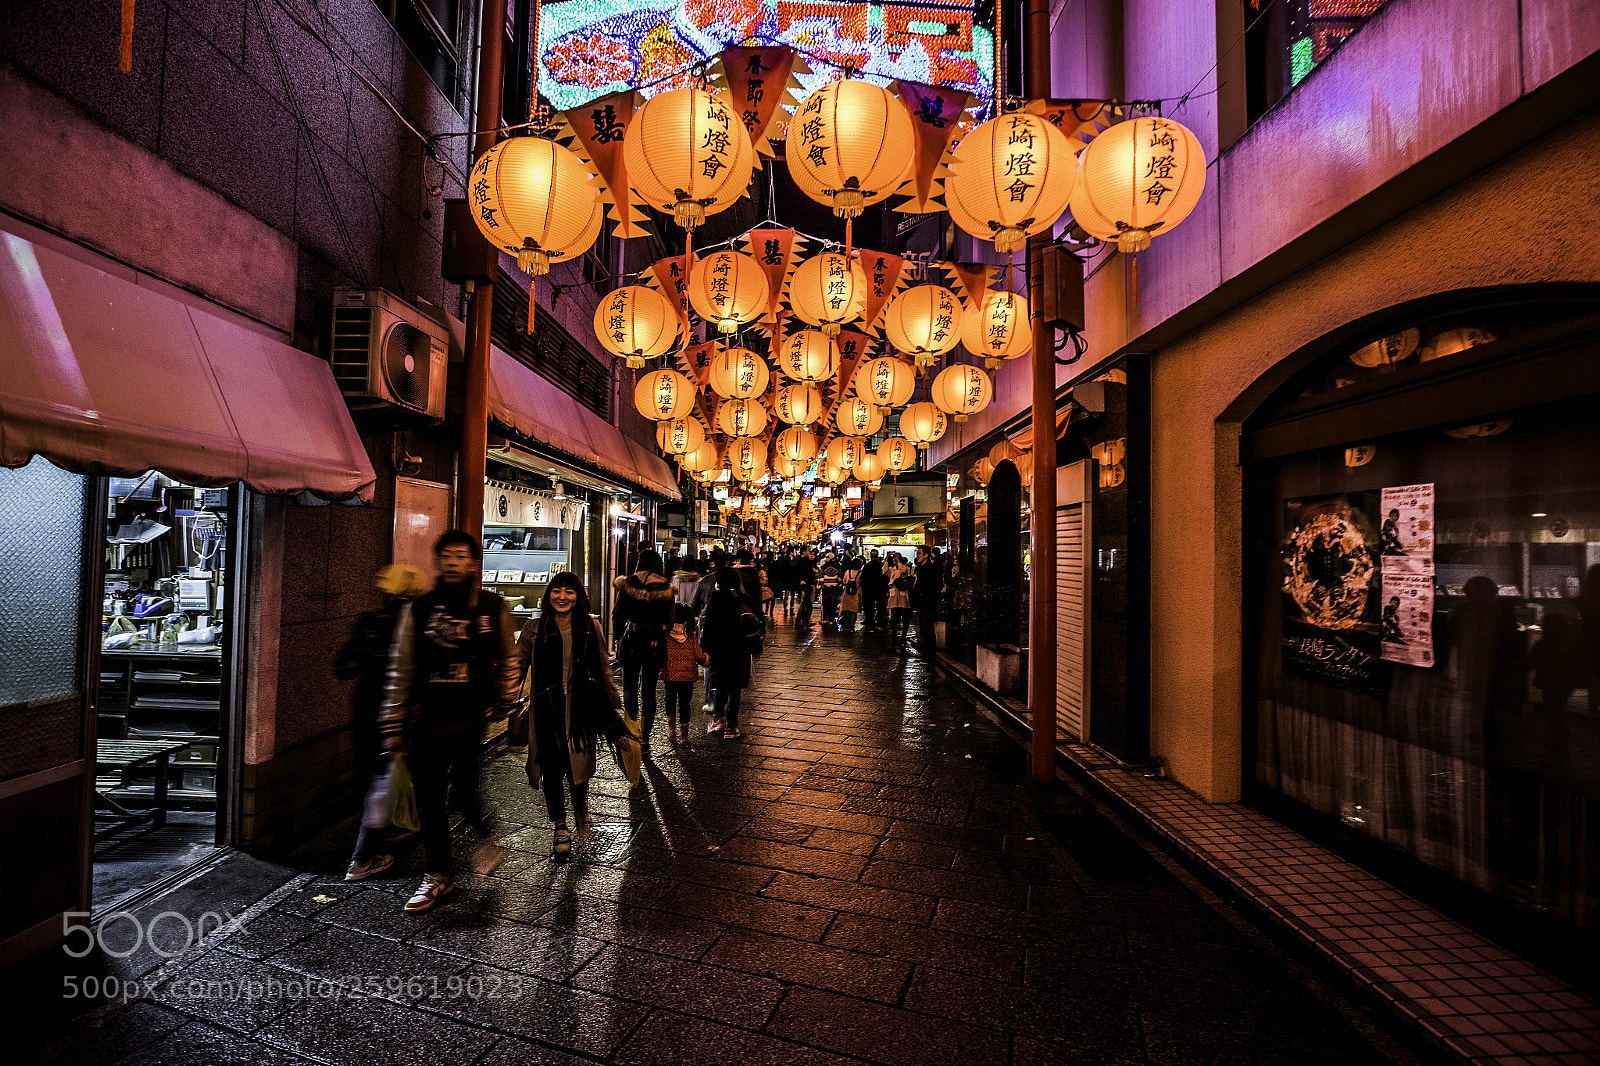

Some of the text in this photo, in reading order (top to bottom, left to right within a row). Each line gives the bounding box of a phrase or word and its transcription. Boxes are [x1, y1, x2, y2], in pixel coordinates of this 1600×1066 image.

[743, 54, 769, 133] 春節祭
[699, 94, 732, 180] 長崎燈會
[1003, 116, 1038, 204] 長崎燈會
[1141, 119, 1179, 206] 長崎燈會
[710, 253, 733, 306] 長崎燈會
[827, 256, 847, 310] 長崎燈會
[608, 288, 629, 343] 長崎燈會
[933, 290, 954, 342] 長崎燈會
[739, 352, 755, 392] 長崎燈會
[790, 333, 804, 372] 長崎燈會
[658, 374, 673, 414] 長崎燈會
[874, 360, 889, 399] 長崎燈會
[967, 368, 982, 406] 長崎燈會
